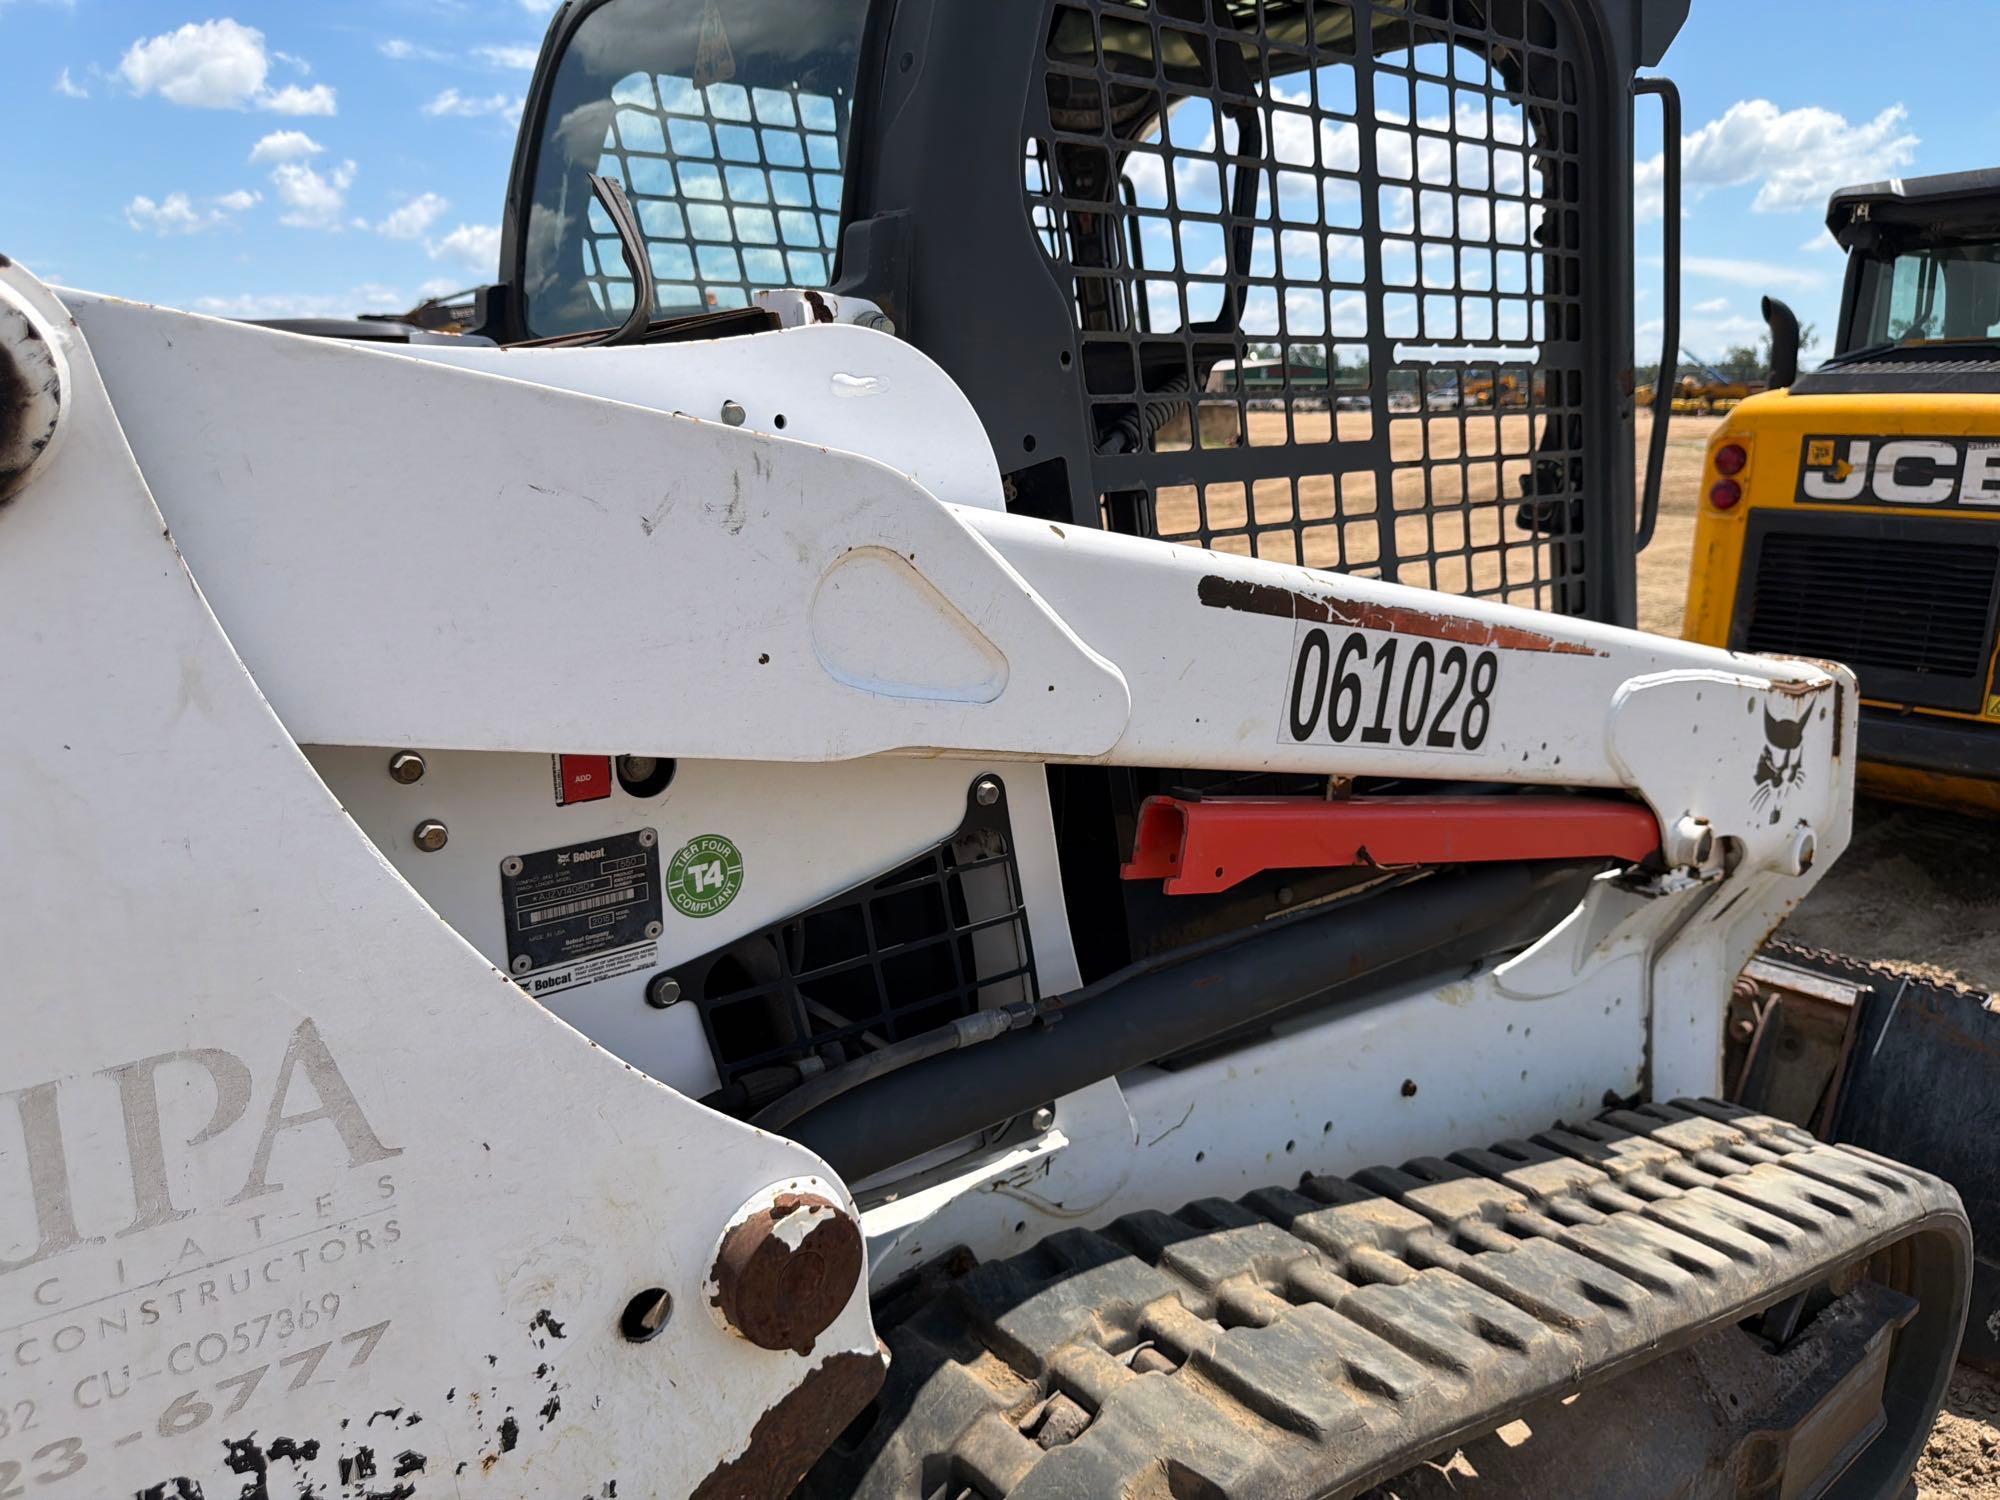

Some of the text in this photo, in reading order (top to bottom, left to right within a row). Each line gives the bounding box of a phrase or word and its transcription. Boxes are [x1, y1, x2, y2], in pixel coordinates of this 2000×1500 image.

[1289, 628, 1498, 751] 061028
[575, 773, 592, 783] ADD
[573, 848, 605, 863] Bobcat
[674, 840, 731, 868] TIER FOUR
[687, 859, 724, 893] T4
[675, 881, 736, 912] COMPLIANT
[535, 972, 572, 991] Bobcat
[0, 1017, 403, 1275] IPA
[14, 1219, 402, 1367] CONSTRUCTORS
